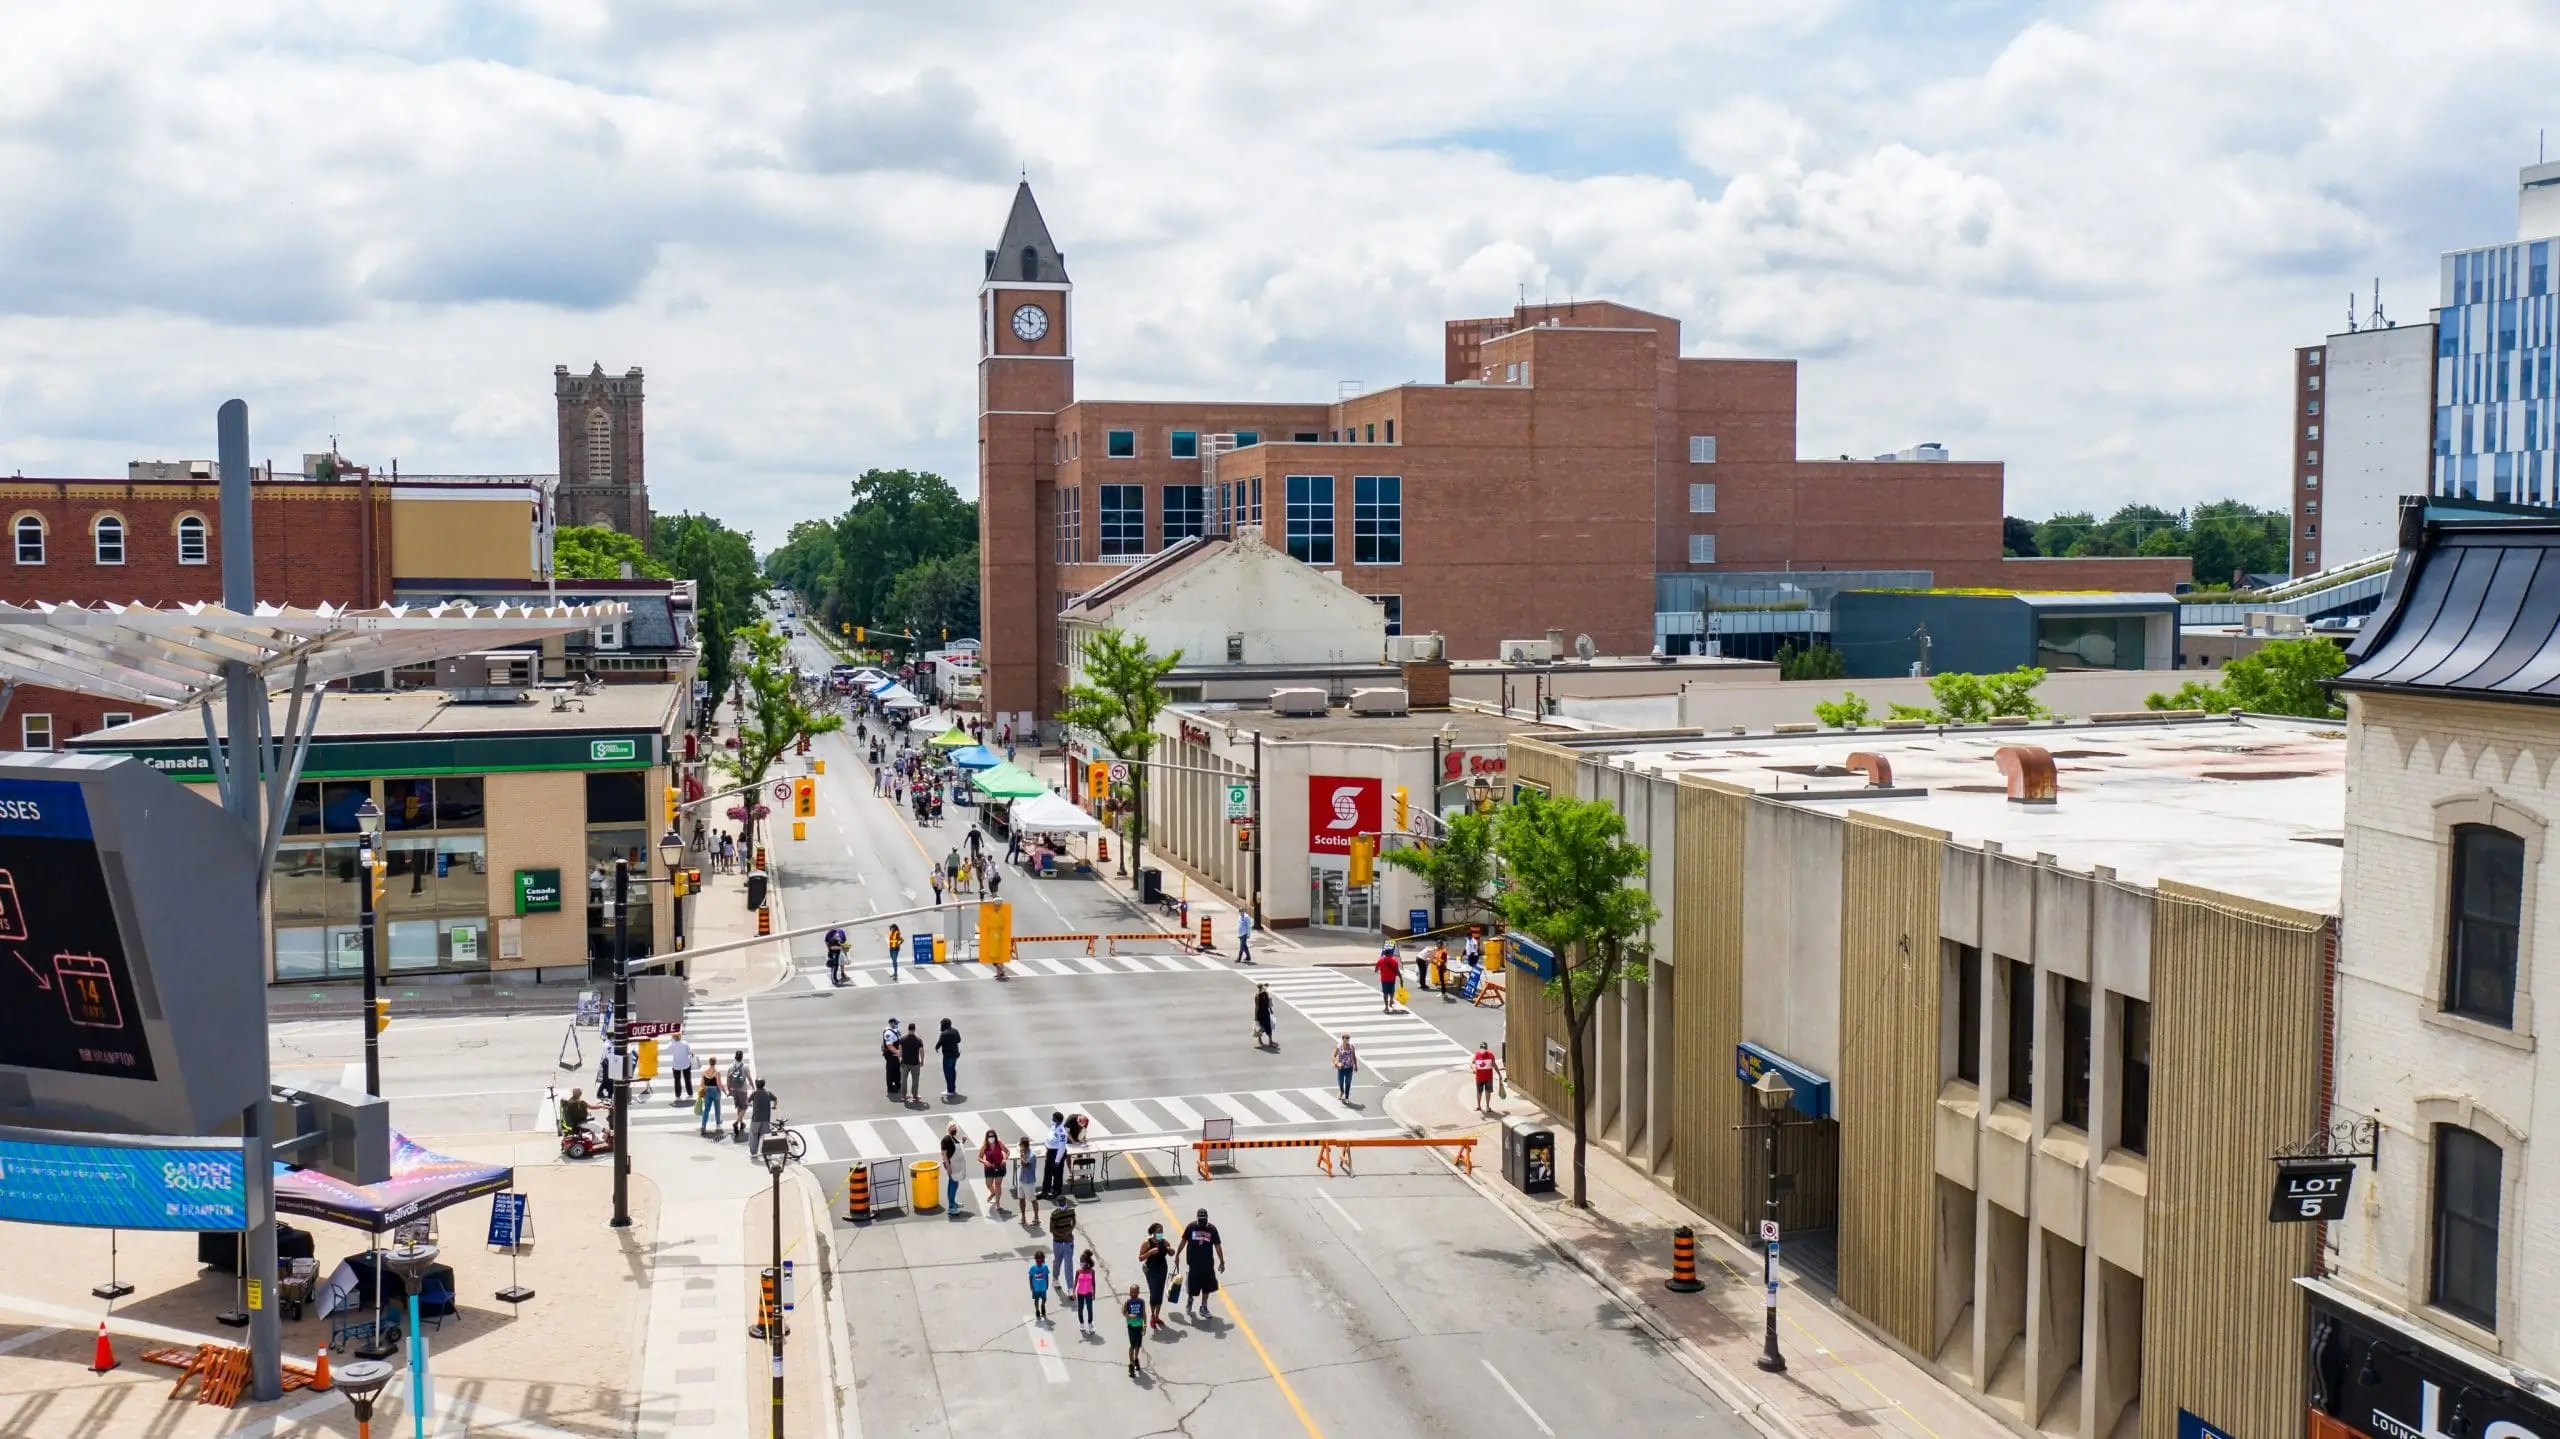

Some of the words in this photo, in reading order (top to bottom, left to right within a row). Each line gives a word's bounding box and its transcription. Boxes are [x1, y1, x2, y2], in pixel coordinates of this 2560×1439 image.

[143, 756, 209, 769] Canada
[1314, 834, 1376, 847] Scotia
[526, 887, 556, 895] Canada
[77, 979, 100, 1003] 14
[632, 1024, 657, 1035] QUEEN
[659, 1024, 668, 1033] ST
[670, 1023, 676, 1032] E
[163, 1162, 232, 1177] GARDEN
[164, 1175, 232, 1191] SQUARE
[2289, 1178, 2342, 1192] LOT
[183, 1203, 234, 1216] BRAMPTON
[385, 1202, 419, 1224] Festivals
[2300, 1199, 2322, 1216] 5
